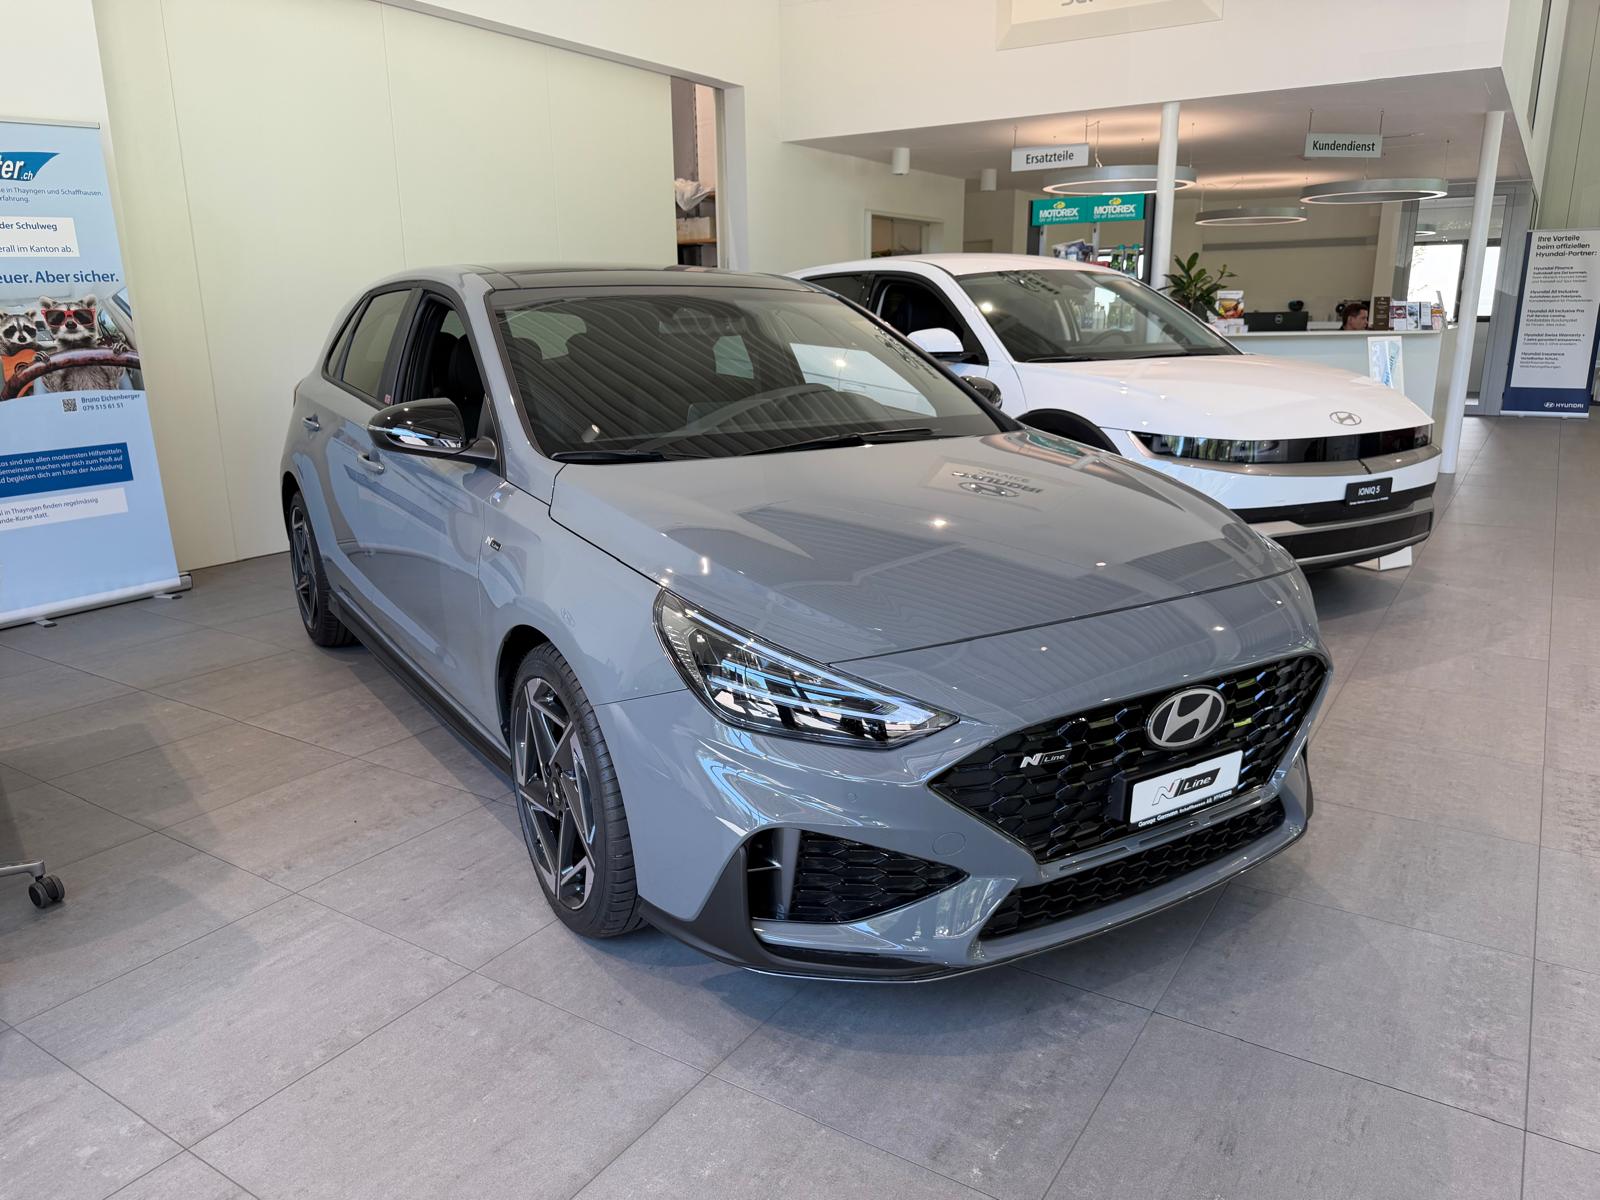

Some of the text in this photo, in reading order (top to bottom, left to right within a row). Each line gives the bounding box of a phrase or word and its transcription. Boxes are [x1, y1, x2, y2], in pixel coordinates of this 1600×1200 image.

[1312, 140, 1376, 151] Kundendienst
[1025, 150, 1075, 165] Ersatzteile
[14, 186, 46, 196] Thayngen
[1039, 207, 1080, 218] MOTOREX
[1094, 203, 1136, 215] MOTOREX
[16, 222, 58, 232] Schulweg
[17, 245, 28, 253] im
[29, 245, 60, 253] Kanton
[61, 245, 74, 253] ab.
[1535, 250, 1598, 258] Hyundai-Partner:
[35, 270, 71, 283] Aber
[73, 269, 119, 283] sicher.
[81, 393, 140, 404] Bruno Eichenberger
[23, 457, 35, 465] mit
[52, 452, 88, 461] modernsten
[36, 463, 60, 472] machen
[71, 459, 84, 467] dich
[7, 473, 36, 484] begleiten
[37, 471, 51, 479] dich
[89, 463, 123, 473] Ausbildung
[1358, 485, 1381, 496] IONIQ 5
[11, 505, 42, 516] Thayngen
[42, 502, 63, 510] finden
[1019, 752, 1066, 769] N Line
[1151, 776, 1212, 806] N Line
[1138, 816, 1156, 828] Garage
